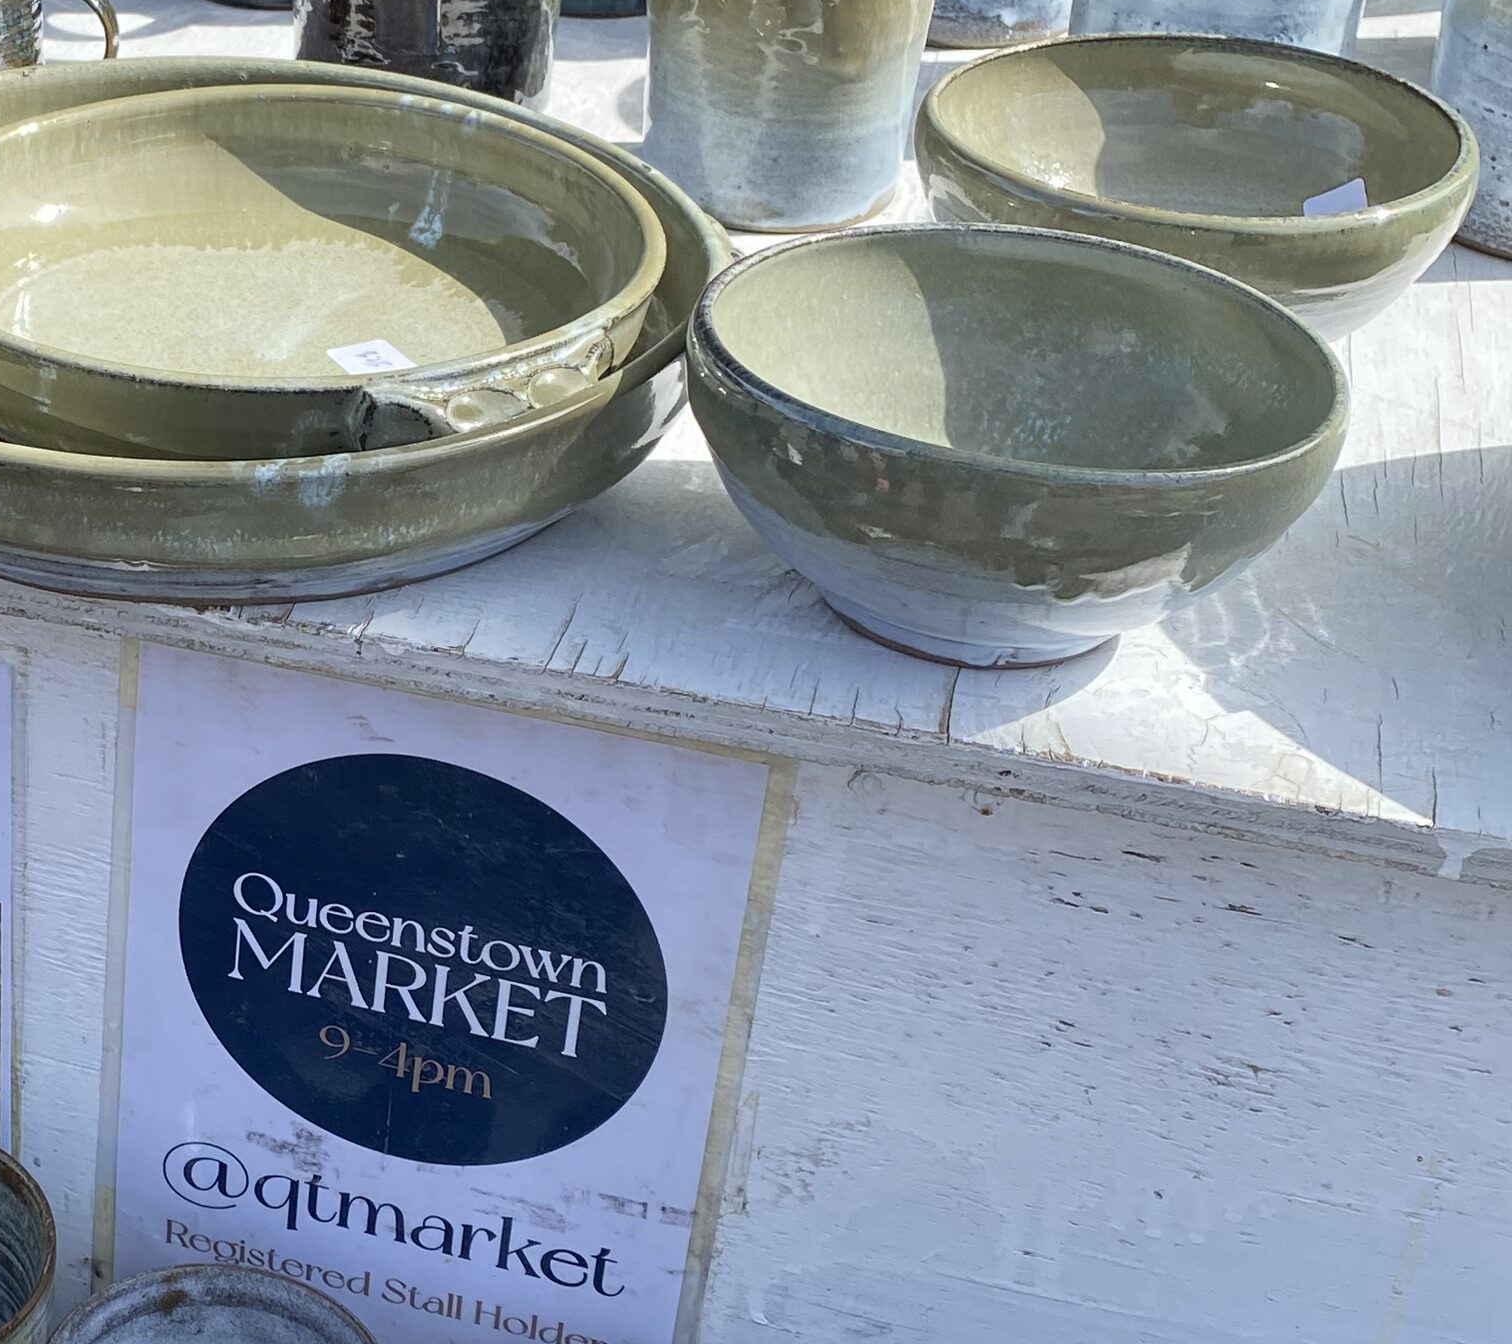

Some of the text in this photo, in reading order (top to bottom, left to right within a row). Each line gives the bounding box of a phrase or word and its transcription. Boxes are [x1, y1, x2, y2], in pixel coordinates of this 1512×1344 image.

[228, 918, 607, 1058] MARKET
[232, 871, 607, 995] Queenstown
[162, 1141, 625, 1298] @qtmarket
[165, 1218, 371, 1297] Registered
[381, 1275, 463, 1322] Stall
